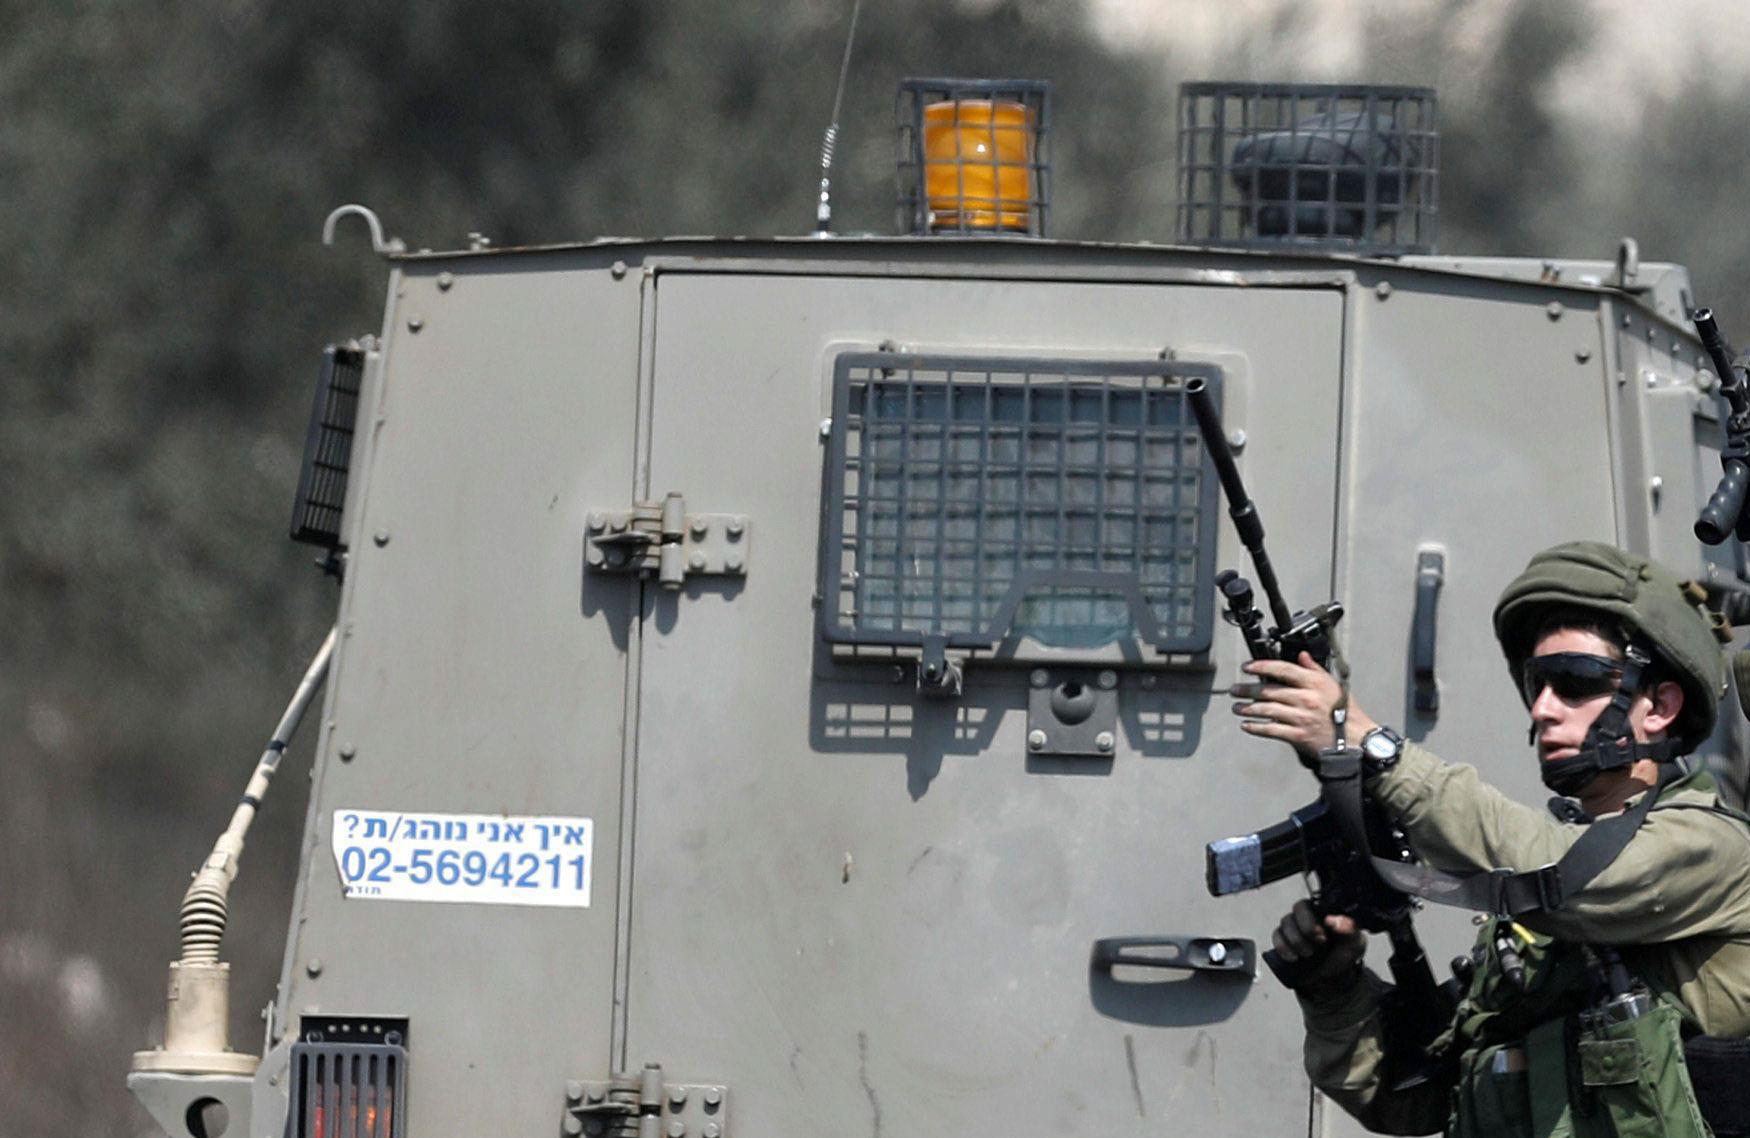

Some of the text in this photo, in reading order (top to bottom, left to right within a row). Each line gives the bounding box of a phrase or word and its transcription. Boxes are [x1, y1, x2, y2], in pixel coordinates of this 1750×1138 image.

[343, 814, 585, 850] איך אני נוהג/ת?
[342, 846, 585, 890] 02-5694211
